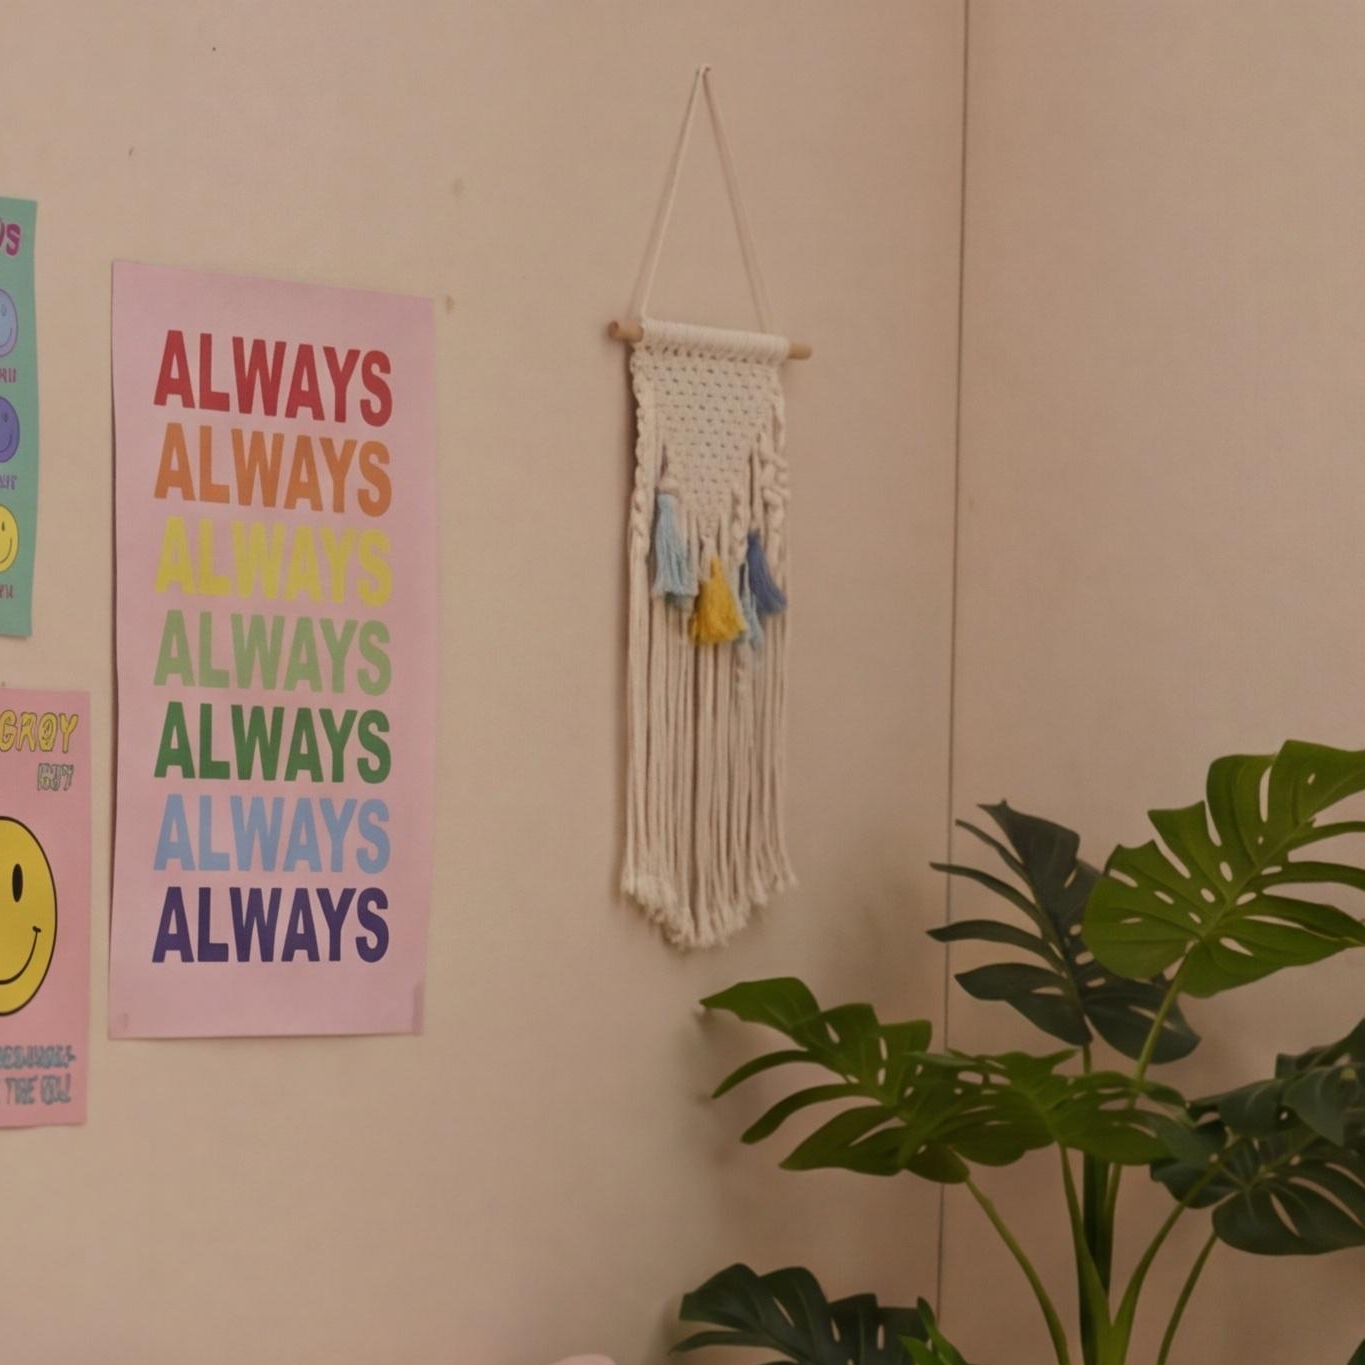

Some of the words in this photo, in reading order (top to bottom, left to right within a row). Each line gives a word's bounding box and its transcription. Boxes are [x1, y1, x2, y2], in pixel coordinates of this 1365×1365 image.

[153, 329, 393, 428] ALWAYS
[153, 421, 393, 518] ALWAYS
[154, 514, 393, 608] ALWAYS
[153, 608, 393, 697] ALWAYS
[153, 701, 393, 785] ALWAYS
[153, 793, 392, 875] ALWAYS
[151, 885, 391, 964] ALWAYS
